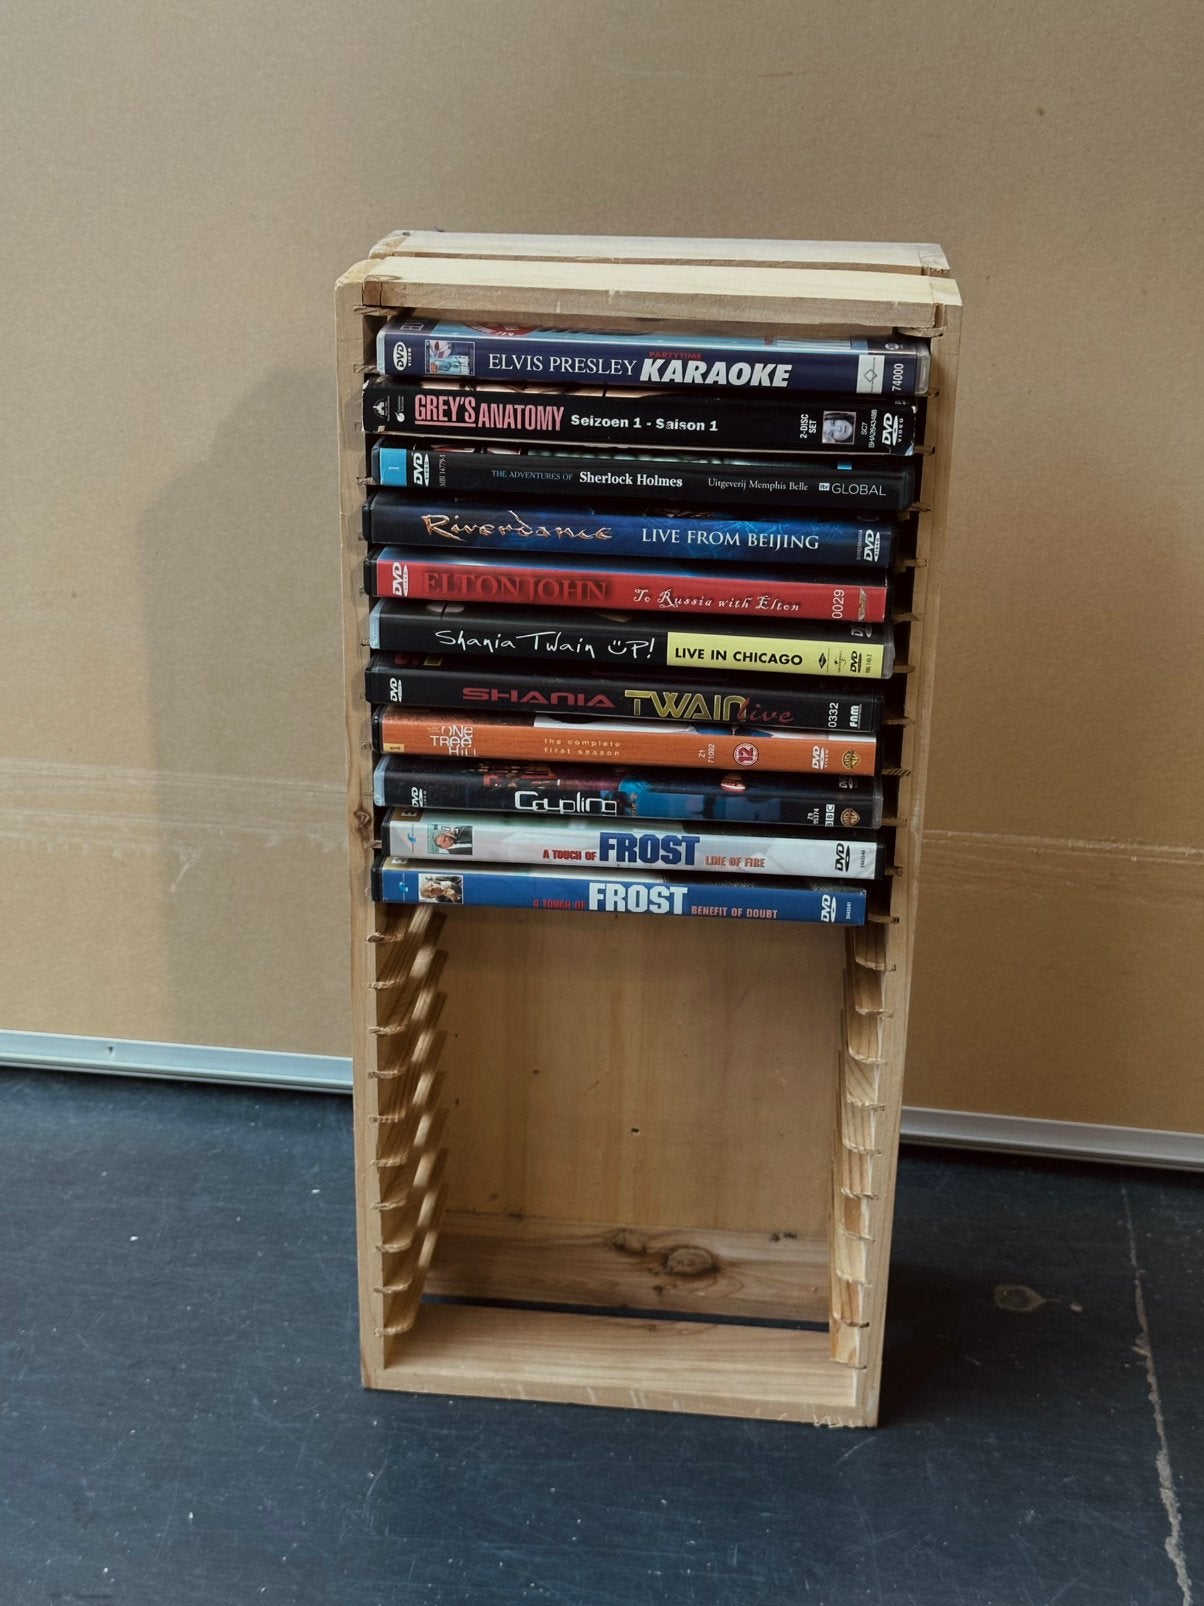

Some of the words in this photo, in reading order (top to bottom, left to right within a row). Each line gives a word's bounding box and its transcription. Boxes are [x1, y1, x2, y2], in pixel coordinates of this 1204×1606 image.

[488, 353, 543, 372] ELVIS
[550, 356, 638, 376] PRESLEY
[649, 351, 703, 360] PARTYTIME
[640, 358, 793, 388] KARAOKE
[892, 363, 904, 392] 74000
[415, 394, 476, 423] GREY'S
[478, 403, 565, 431] ANATOMY
[571, 414, 629, 428] Seizoen
[633, 417, 642, 428] 1
[655, 418, 705, 432] Saison
[709, 420, 718, 431] 1
[800, 414, 808, 439] 2-DISC
[808, 419, 817, 433] SET
[882, 412, 893, 445] DVD
[413, 452, 423, 486] DVD
[491, 470, 507, 478] THE
[508, 471, 561, 480] ADVENTURES
[563, 473, 574, 481] OF
[579, 471, 633, 485] Sherlock
[637, 474, 683, 487] Holmes
[708, 478, 747, 490] Uitgeverij
[749, 479, 787, 491] Memphis
[789, 482, 809, 491] Belle
[832, 482, 886, 496] GLOBAL
[421, 510, 612, 541] Riverdance
[642, 528, 680, 543] LIVE
[687, 530, 740, 546] FROM
[748, 533, 820, 551] BEIJING
[863, 529, 874, 562] DVD
[392, 561, 402, 596] DVD
[423, 572, 519, 598] ELTON
[527, 575, 608, 602] JOHN
[633, 588, 651, 603] To
[657, 588, 712, 608] Russia
[717, 597, 750, 609] with
[755, 595, 800, 611] Elton
[832, 589, 845, 619] 0029
[435, 630, 516, 653] Shania
[516, 631, 596, 658] Twain
[675, 647, 705, 660] LIVE
[710, 649, 727, 661] IN
[733, 651, 802, 666] CHICAGO
[850, 650, 858, 673] DVD
[389, 677, 398, 702] DVD
[462, 687, 616, 708] SHANIA
[624, 689, 748, 722] TWAIN
[736, 697, 795, 724] live
[827, 702, 839, 728] 0332
[544, 747, 571, 755] first
[568, 739, 621, 748] complete
[738, 747, 754, 764] 12
[812, 745, 820, 769] DVD
[411, 786, 419, 807] DVD
[514, 790, 618, 816] Coupling
[542, 850, 549, 859] A
[552, 850, 582, 861] TOUCH
[585, 851, 597, 861] OF
[599, 831, 700, 866] FROST
[705, 855, 726, 866] LINE
[729, 857, 742, 867] OF
[744, 857, 765, 868] FIRE
[834, 842, 845, 872] DVD
[533, 900, 539, 908] A
[542, 900, 571, 910] TOUCH
[574, 901, 587, 910] OF
[588, 882, 688, 915] FROST
[691, 906, 727, 917] BENEFIT
[731, 907, 743, 917] OF
[746, 908, 778, 919] DOUBT
[820, 894, 831, 922] DVD
